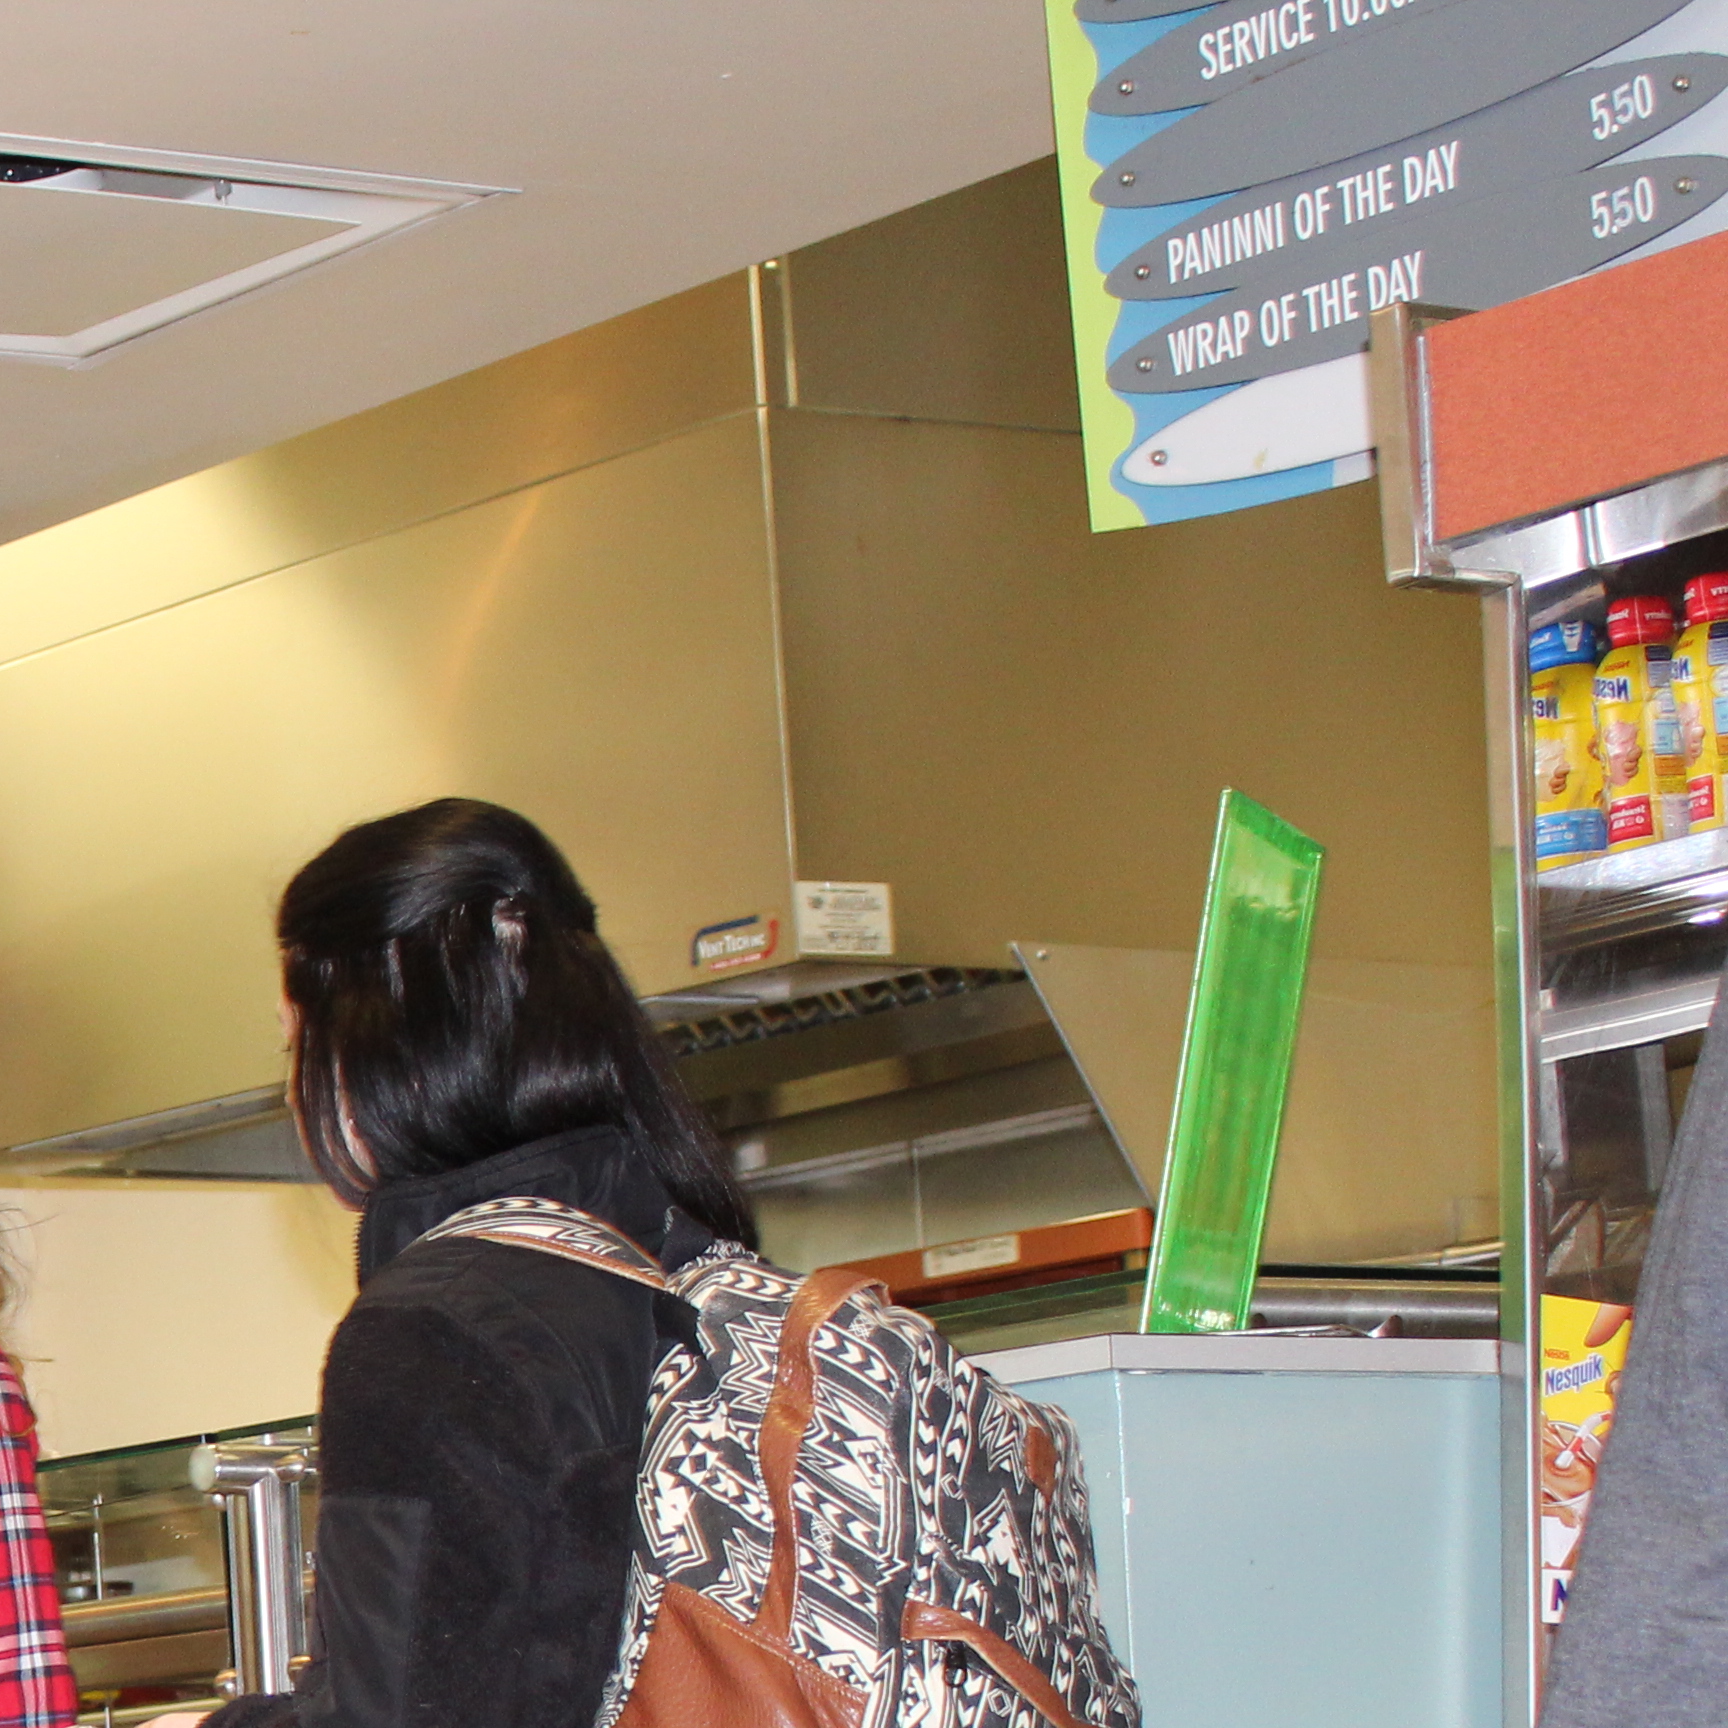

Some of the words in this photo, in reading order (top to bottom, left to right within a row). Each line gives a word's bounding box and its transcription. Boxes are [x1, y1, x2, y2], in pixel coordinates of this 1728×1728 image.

[1199, 0, 1315, 81] SERVICE
[1590, 75, 1654, 141] 5.50
[1166, 202, 1286, 284] PANINNI
[1292, 185, 1333, 241] OF
[1337, 163, 1394, 226] THE
[1402, 140, 1460, 204] DAY
[1590, 176, 1656, 239] 5.50
[1167, 318, 1251, 377] WRAP
[1260, 292, 1299, 348] OF
[1302, 271, 1360, 332] THE
[1368, 250, 1424, 309] DAY
[1545, 1354, 1603, 1397] Nesquik
